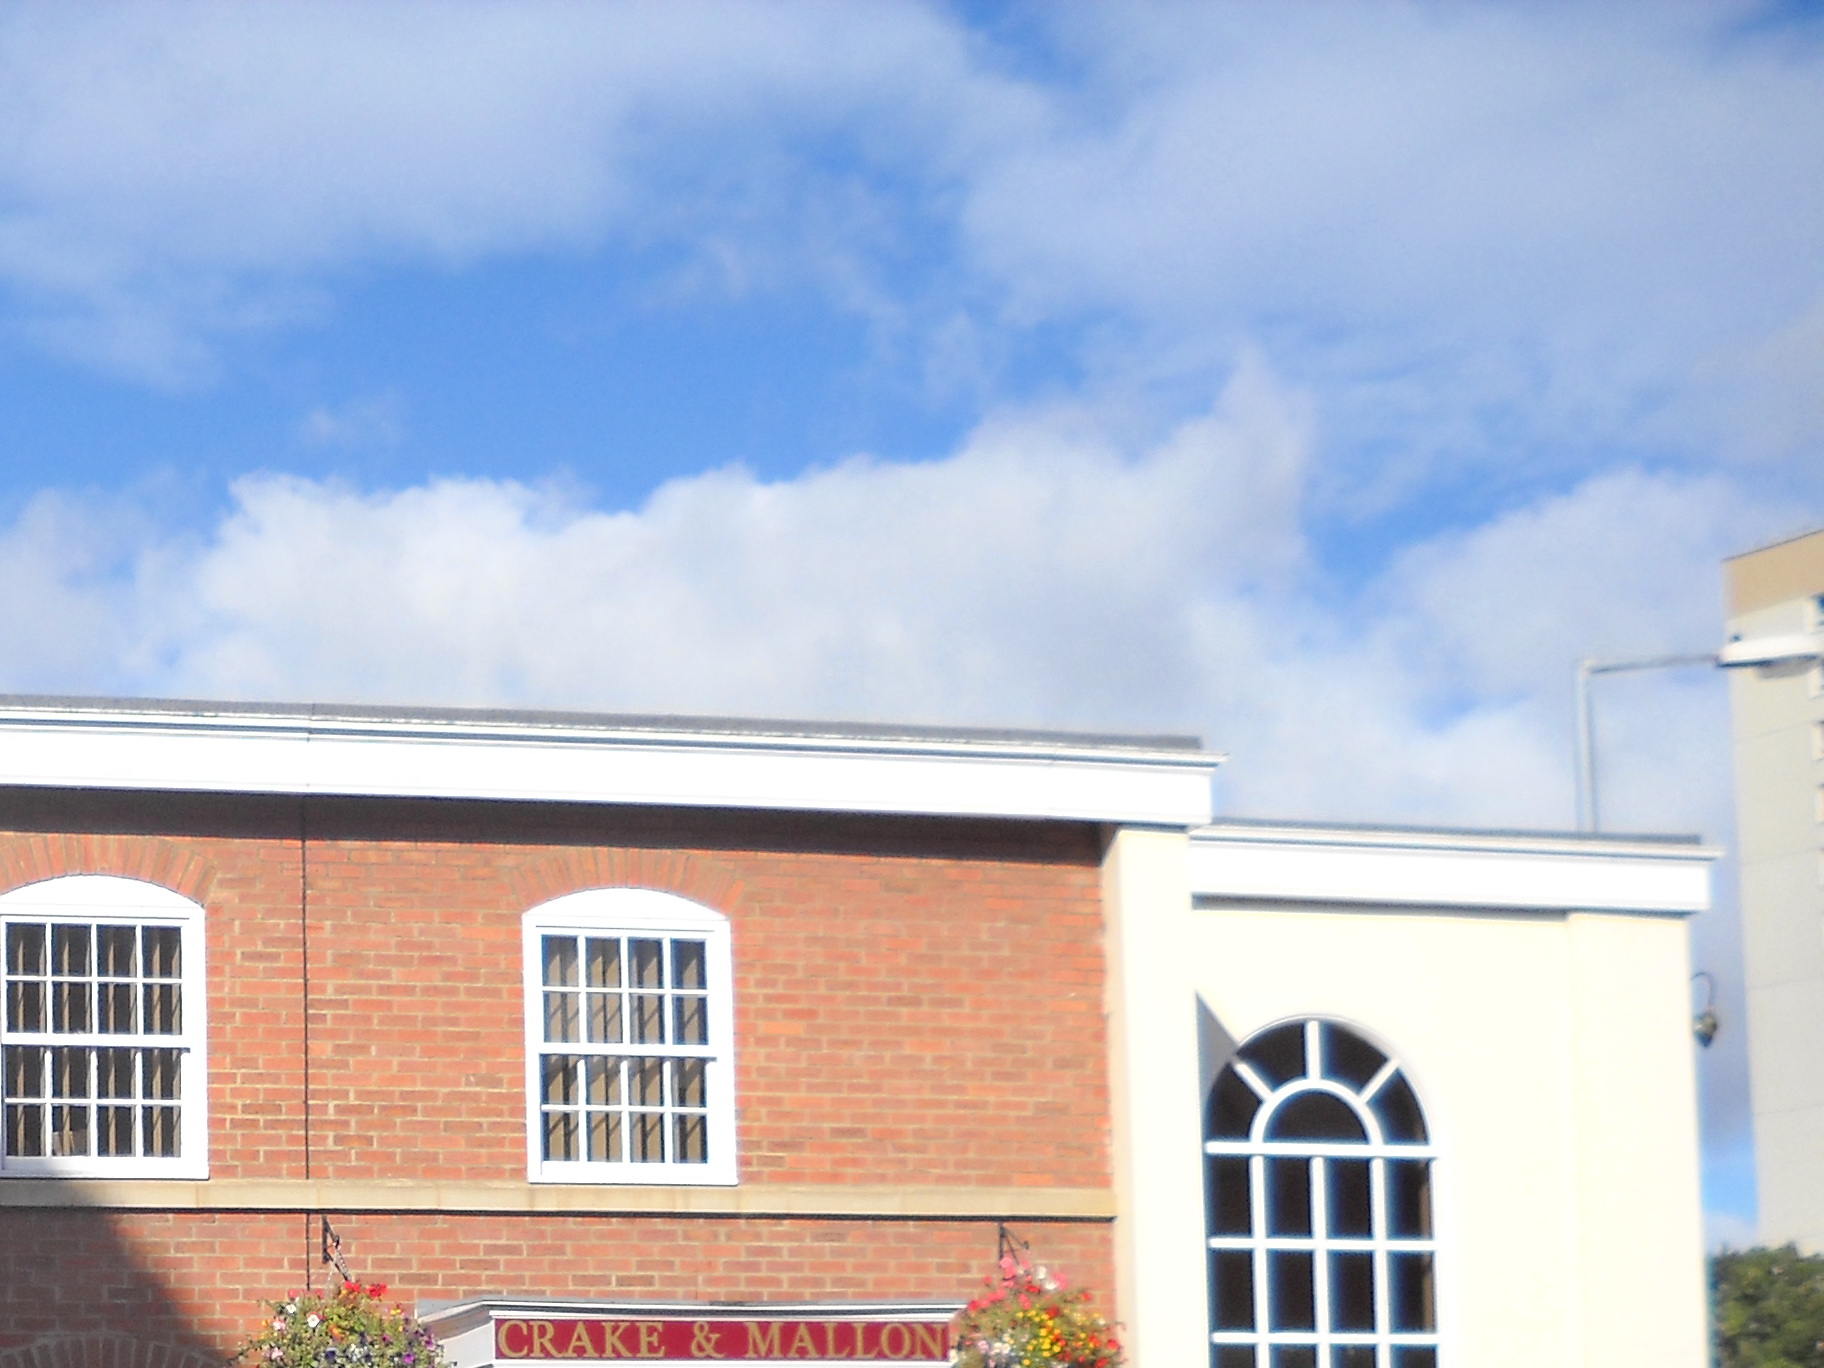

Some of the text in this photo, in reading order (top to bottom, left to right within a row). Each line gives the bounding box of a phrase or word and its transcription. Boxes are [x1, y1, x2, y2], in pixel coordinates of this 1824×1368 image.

[497, 1320, 944, 1359] CRAKE & MALLON
